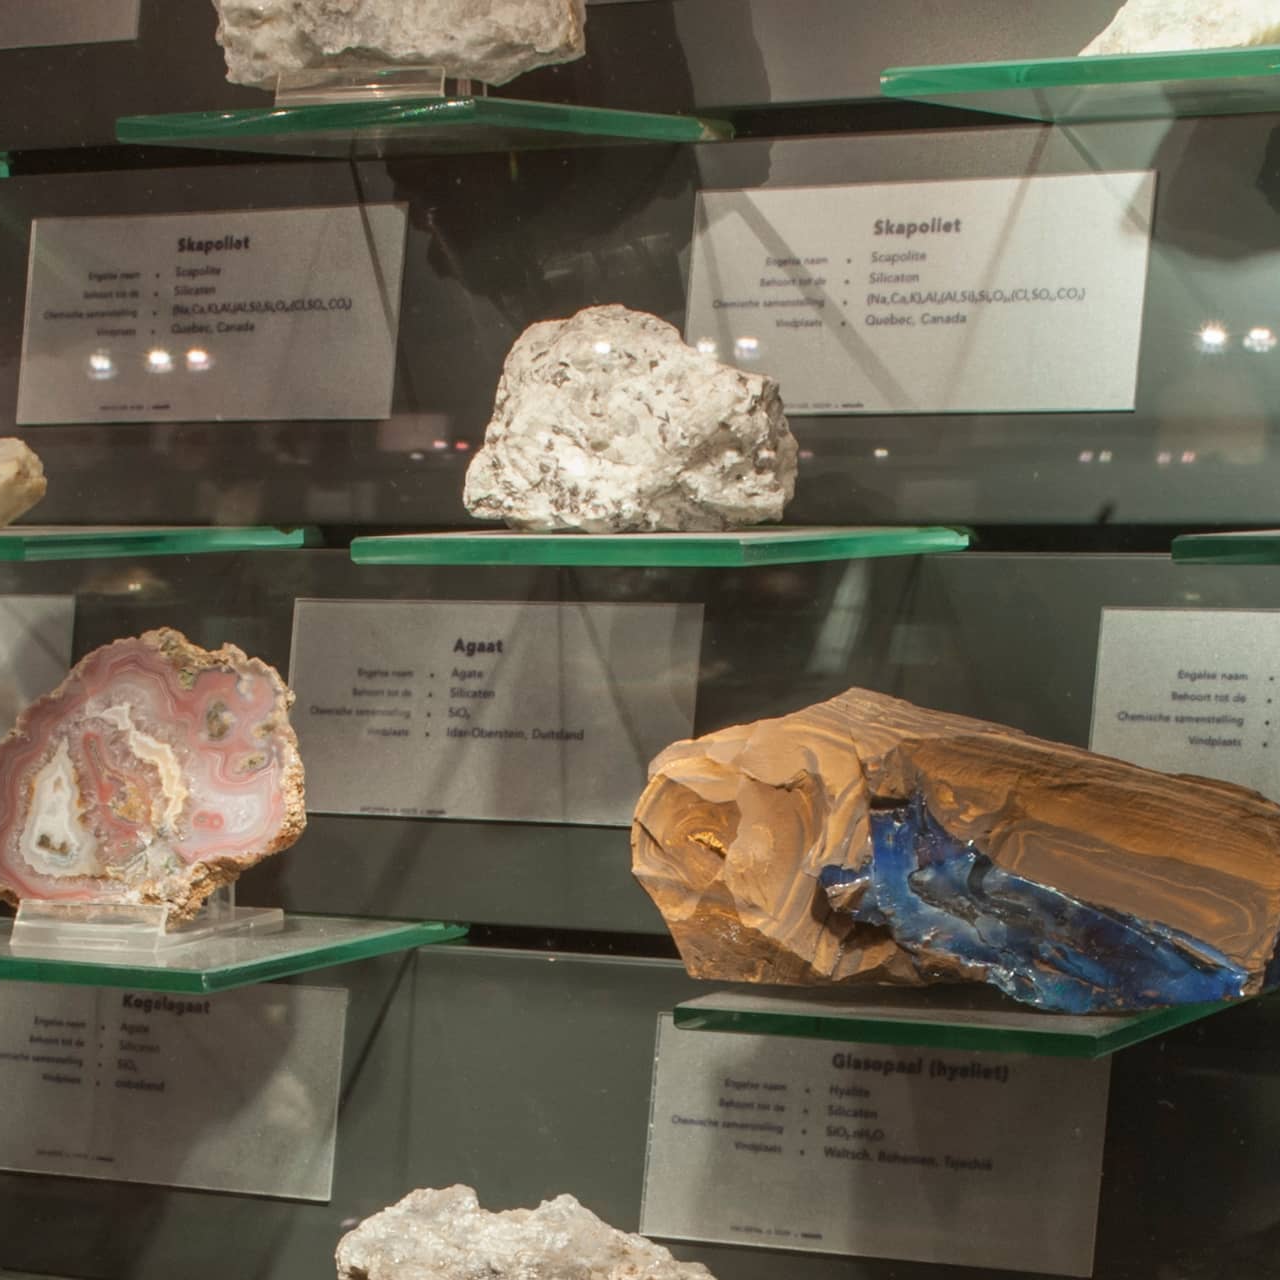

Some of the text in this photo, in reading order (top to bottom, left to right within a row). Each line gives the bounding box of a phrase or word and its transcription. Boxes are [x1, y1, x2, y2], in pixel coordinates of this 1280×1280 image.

[873, 217, 961, 239] Skapoliet
[177, 236, 250, 254] Skapoliet
[453, 638, 504, 658] Agaat
[832, 1053, 922, 1077] Glasopaal
